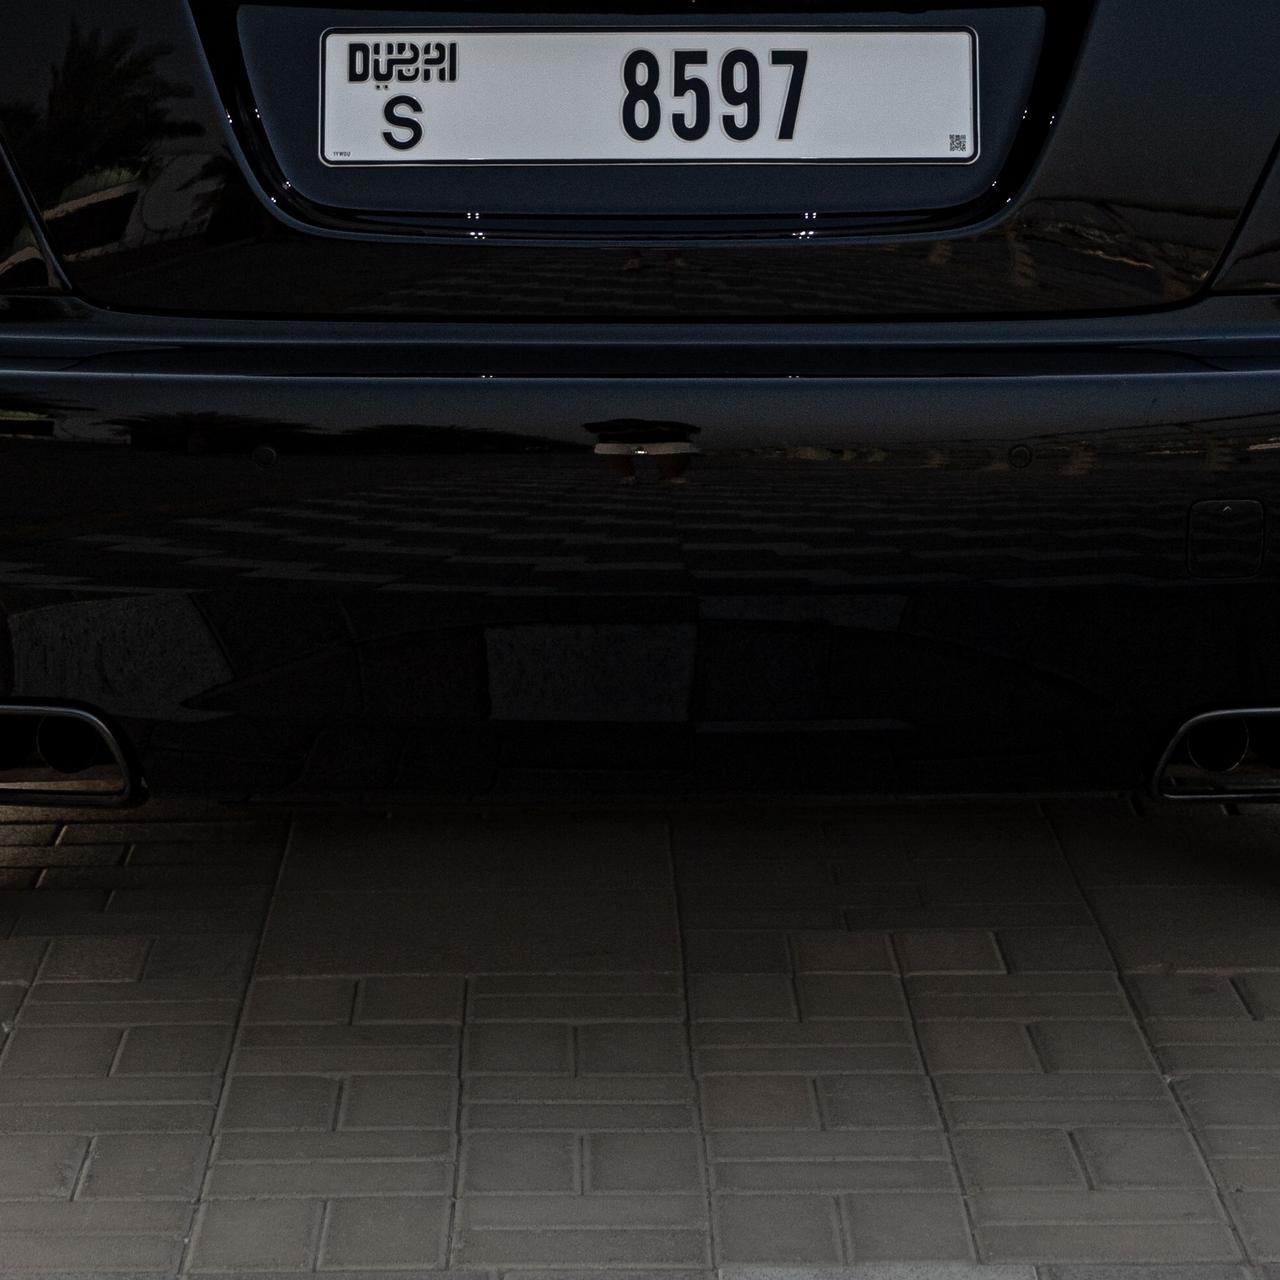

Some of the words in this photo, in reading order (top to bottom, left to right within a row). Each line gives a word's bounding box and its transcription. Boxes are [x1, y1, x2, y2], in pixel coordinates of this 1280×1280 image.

[349, 42, 457, 82] DUBAI
[382, 95, 424, 150] S
[622, 49, 809, 141] 8597
